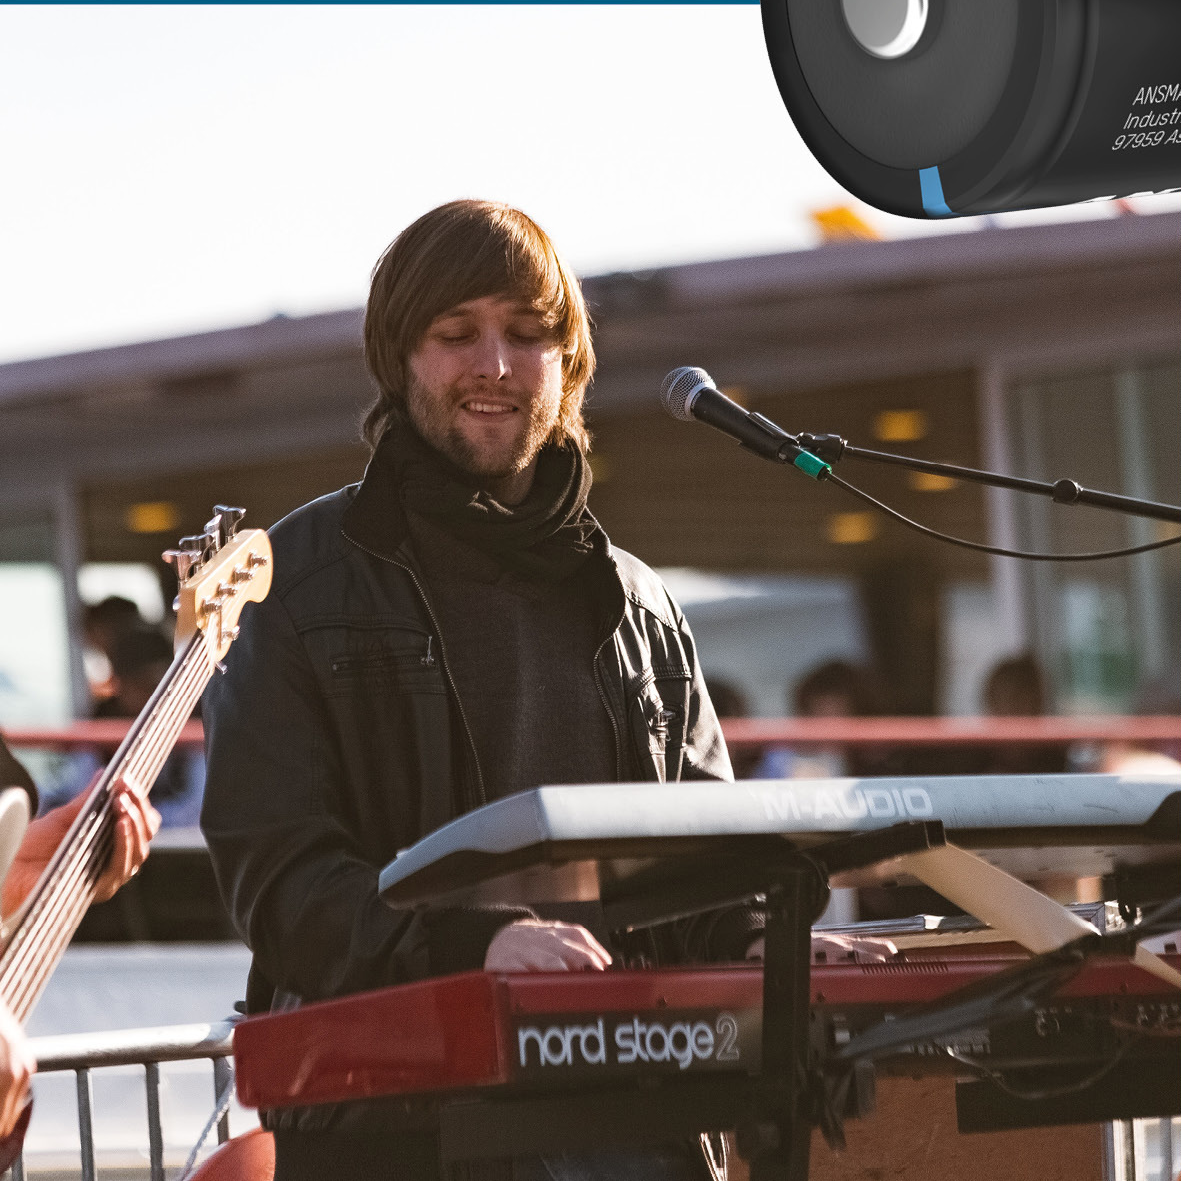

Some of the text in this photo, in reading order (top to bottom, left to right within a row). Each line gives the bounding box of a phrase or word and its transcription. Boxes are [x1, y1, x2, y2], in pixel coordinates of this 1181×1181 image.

[1111, 130, 1165, 151] 97959
[758, 787, 934, 820] M-AUDIO
[517, 1016, 607, 1068] nord
